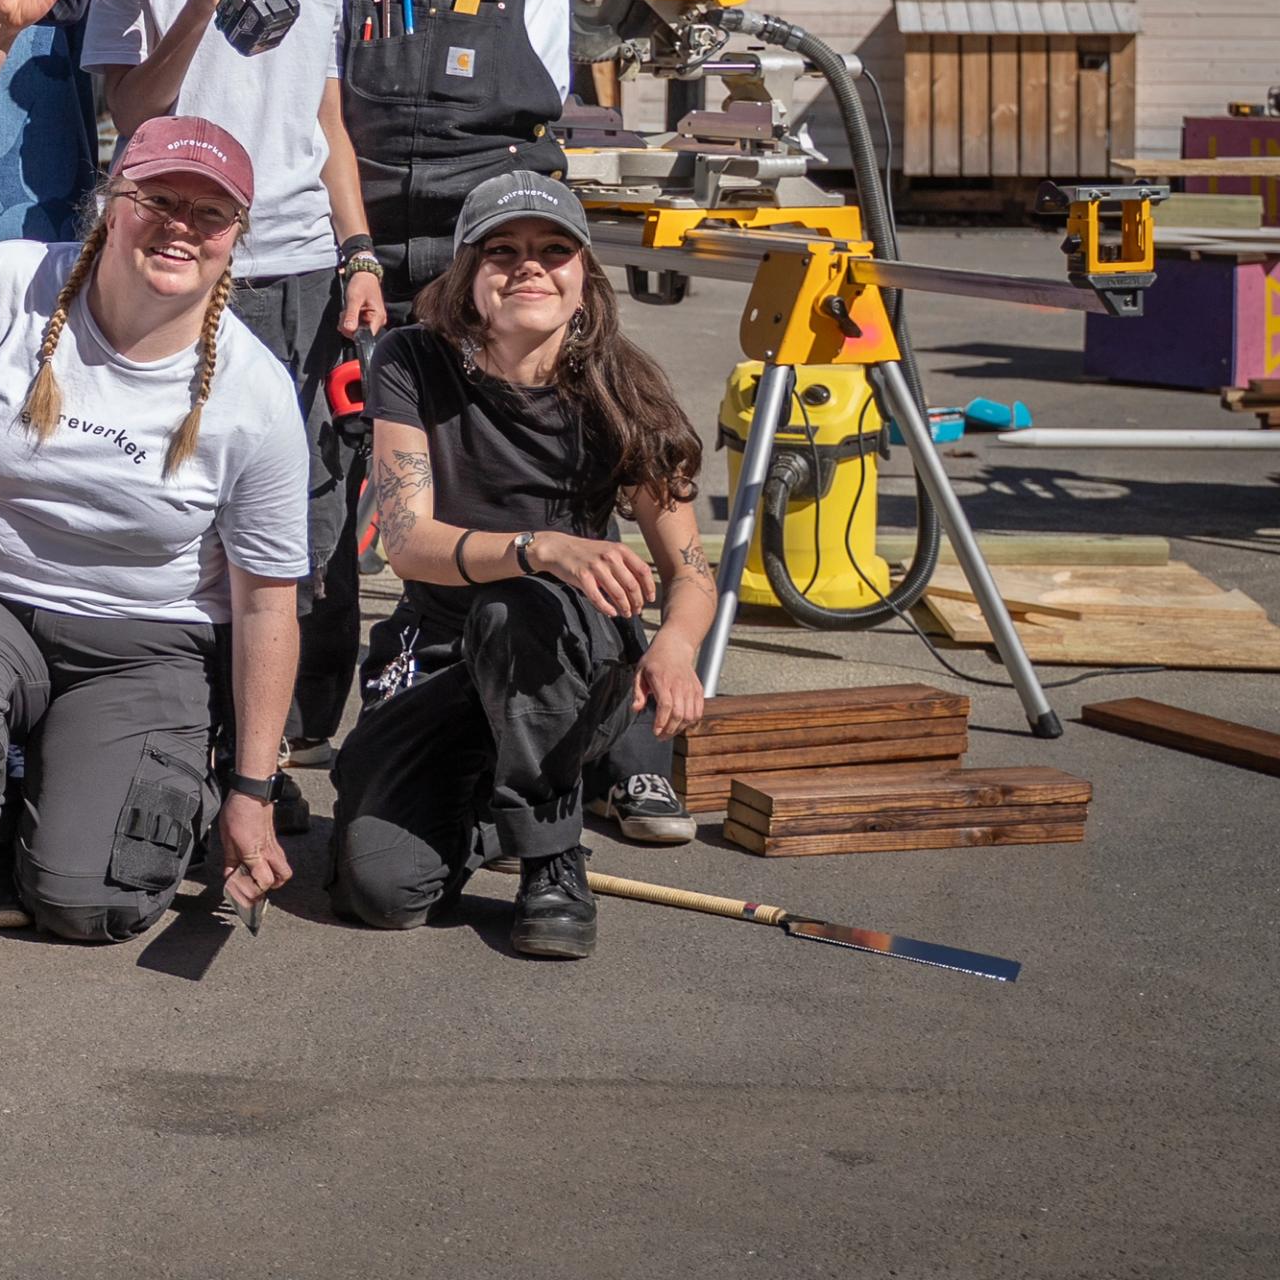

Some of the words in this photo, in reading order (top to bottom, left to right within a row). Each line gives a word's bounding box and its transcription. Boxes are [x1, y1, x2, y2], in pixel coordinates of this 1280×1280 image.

[166, 138, 228, 164] spireverket
[497, 189, 559, 206] spireverket
[21, 411, 147, 465] sreverket
